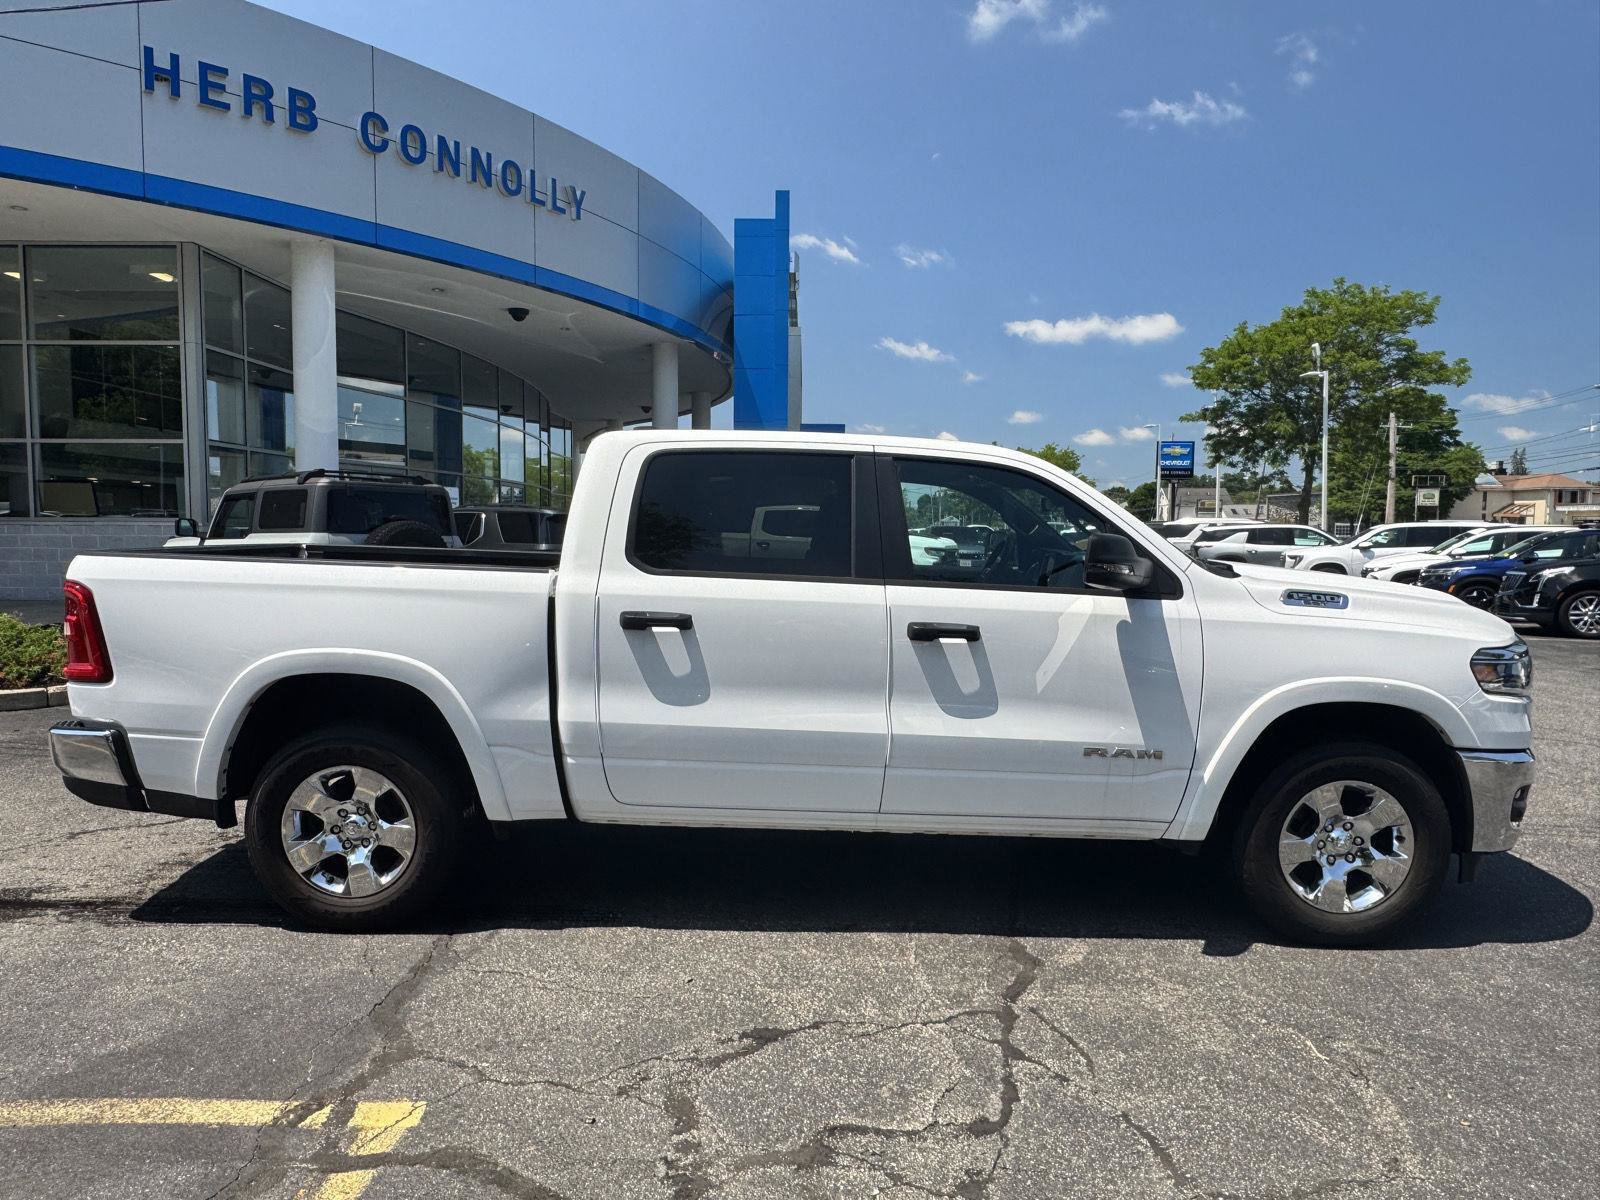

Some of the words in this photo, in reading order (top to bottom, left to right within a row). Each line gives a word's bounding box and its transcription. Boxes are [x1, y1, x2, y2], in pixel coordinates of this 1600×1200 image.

[142, 45, 319, 133] HERB
[357, 111, 586, 222] CONNOLLY
[1288, 591, 1343, 604] 1500
[1083, 747, 1163, 760] RAM
